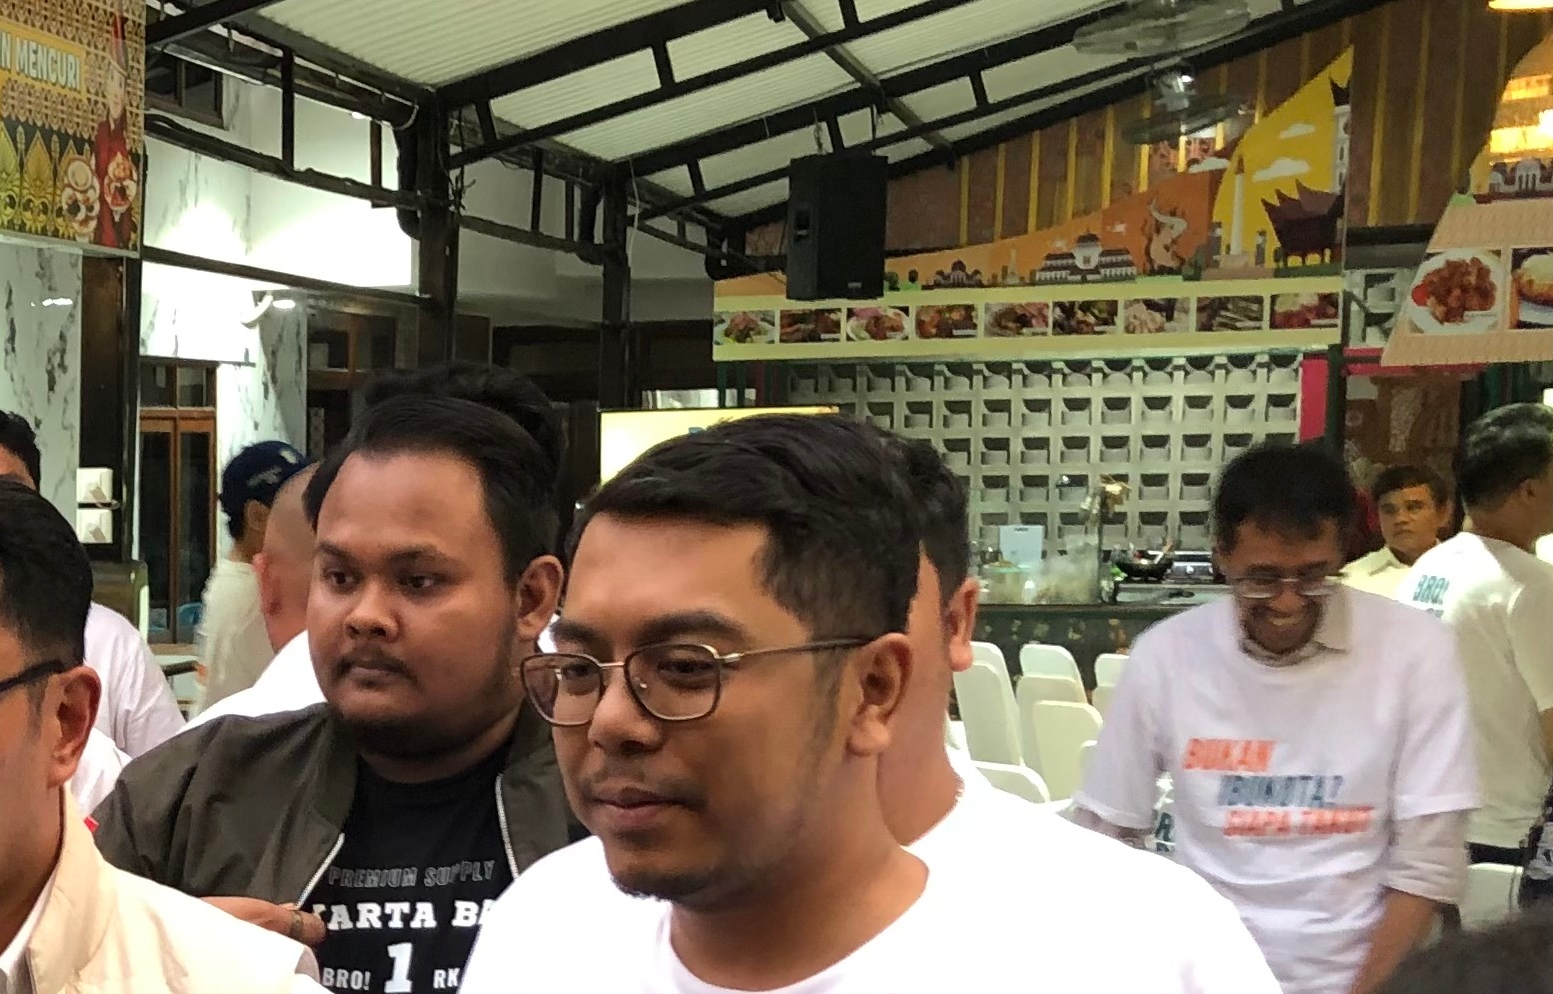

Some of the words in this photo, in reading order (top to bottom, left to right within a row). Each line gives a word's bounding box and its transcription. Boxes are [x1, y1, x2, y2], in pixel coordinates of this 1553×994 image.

[15, 37, 81, 92] MENCURI
[328, 864, 418, 888] PREMIUM
[423, 860, 496, 887] SUPPLY
[313, 901, 437, 930] ARTA
[322, 967, 371, 991] BRO!
[384, 942, 414, 994] 1
[433, 968, 461, 989] RK
